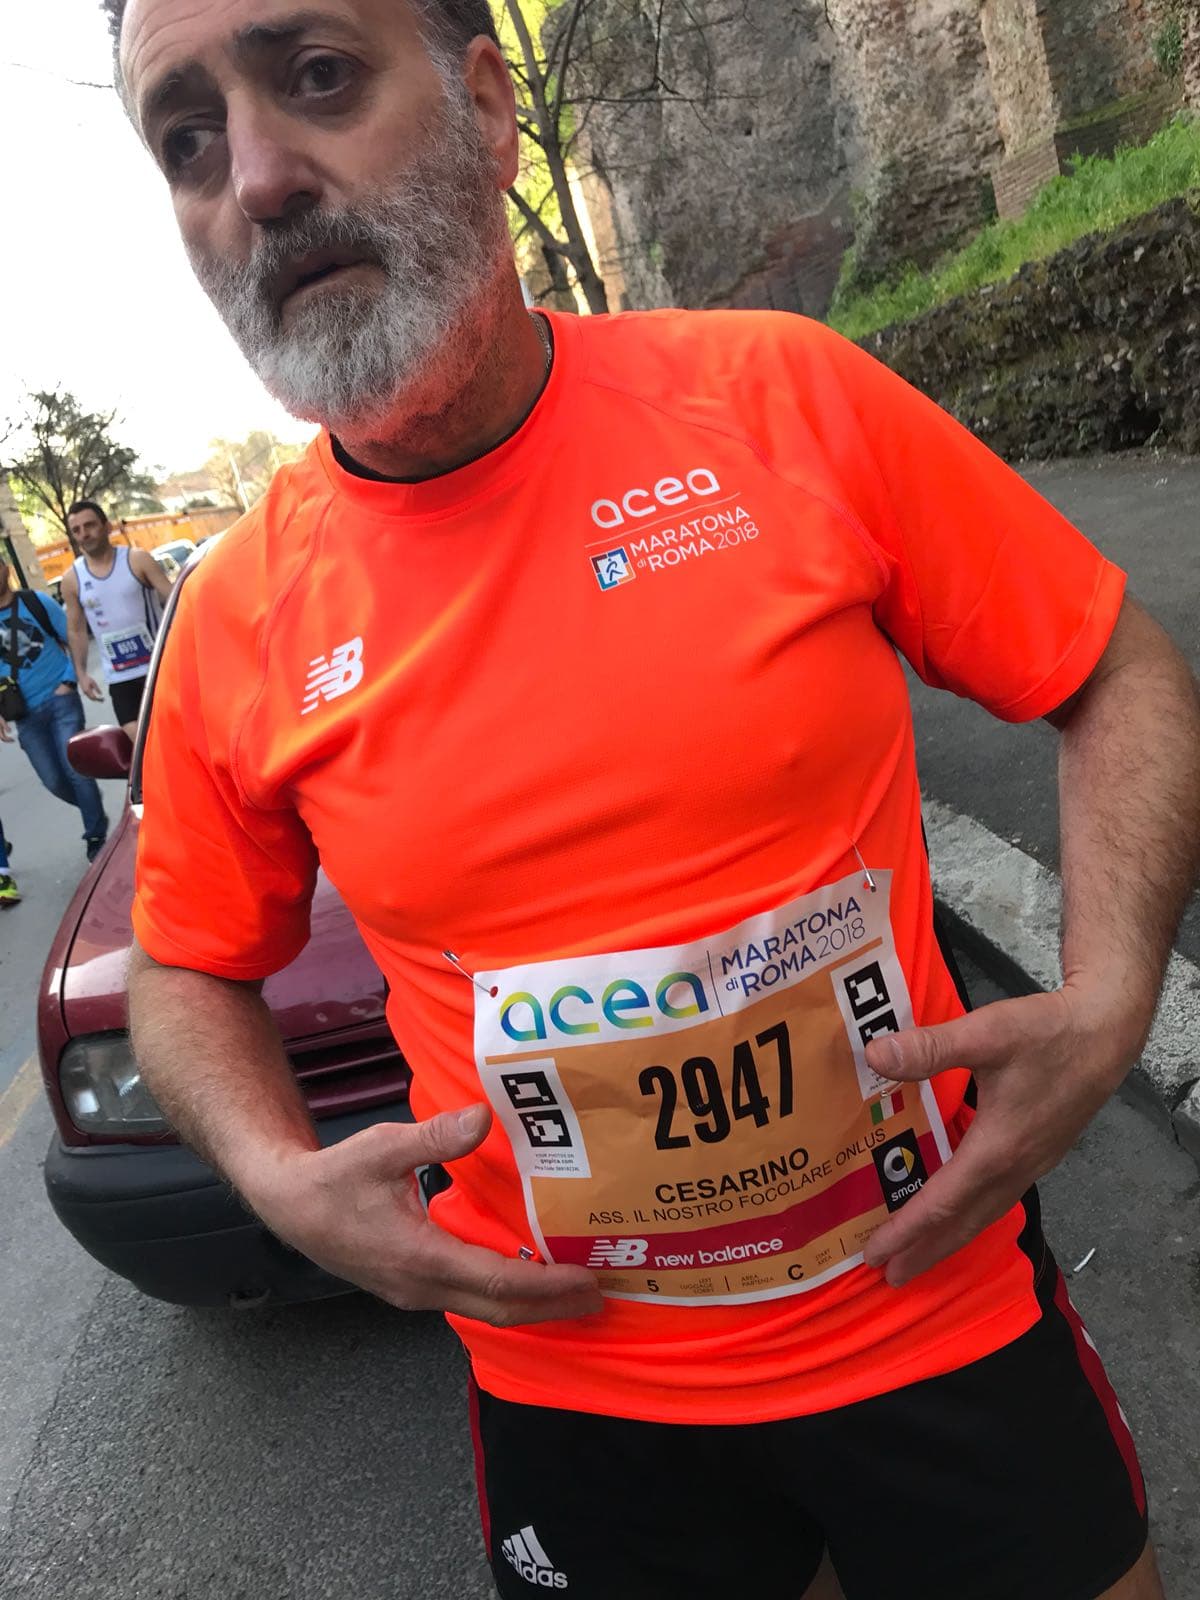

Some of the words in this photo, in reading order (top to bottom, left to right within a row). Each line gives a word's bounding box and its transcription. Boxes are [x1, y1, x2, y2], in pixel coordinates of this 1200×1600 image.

[591, 468, 721, 529] acea
[629, 506, 751, 557] MARATONA
[637, 559, 647, 569] di
[721, 896, 862, 976] MARATONA
[499, 971, 710, 1042] acea
[725, 977, 739, 992] di
[638, 1020, 794, 1151] 2947
[588, 1211, 629, 1225] ASS.
[634, 1209, 650, 1223] IL
[653, 1198, 734, 1222] NOSTRO
[739, 1161, 832, 1209] FOCOLARE
[835, 1127, 886, 1166] ONLUS
[655, 1148, 809, 1204] CESARINO
[890, 1177, 924, 1202] smart
[655, 1250, 697, 1268] new
[699, 1237, 784, 1266] balance
[787, 1264, 804, 1281] C
[646, 1279, 660, 1293] 5
